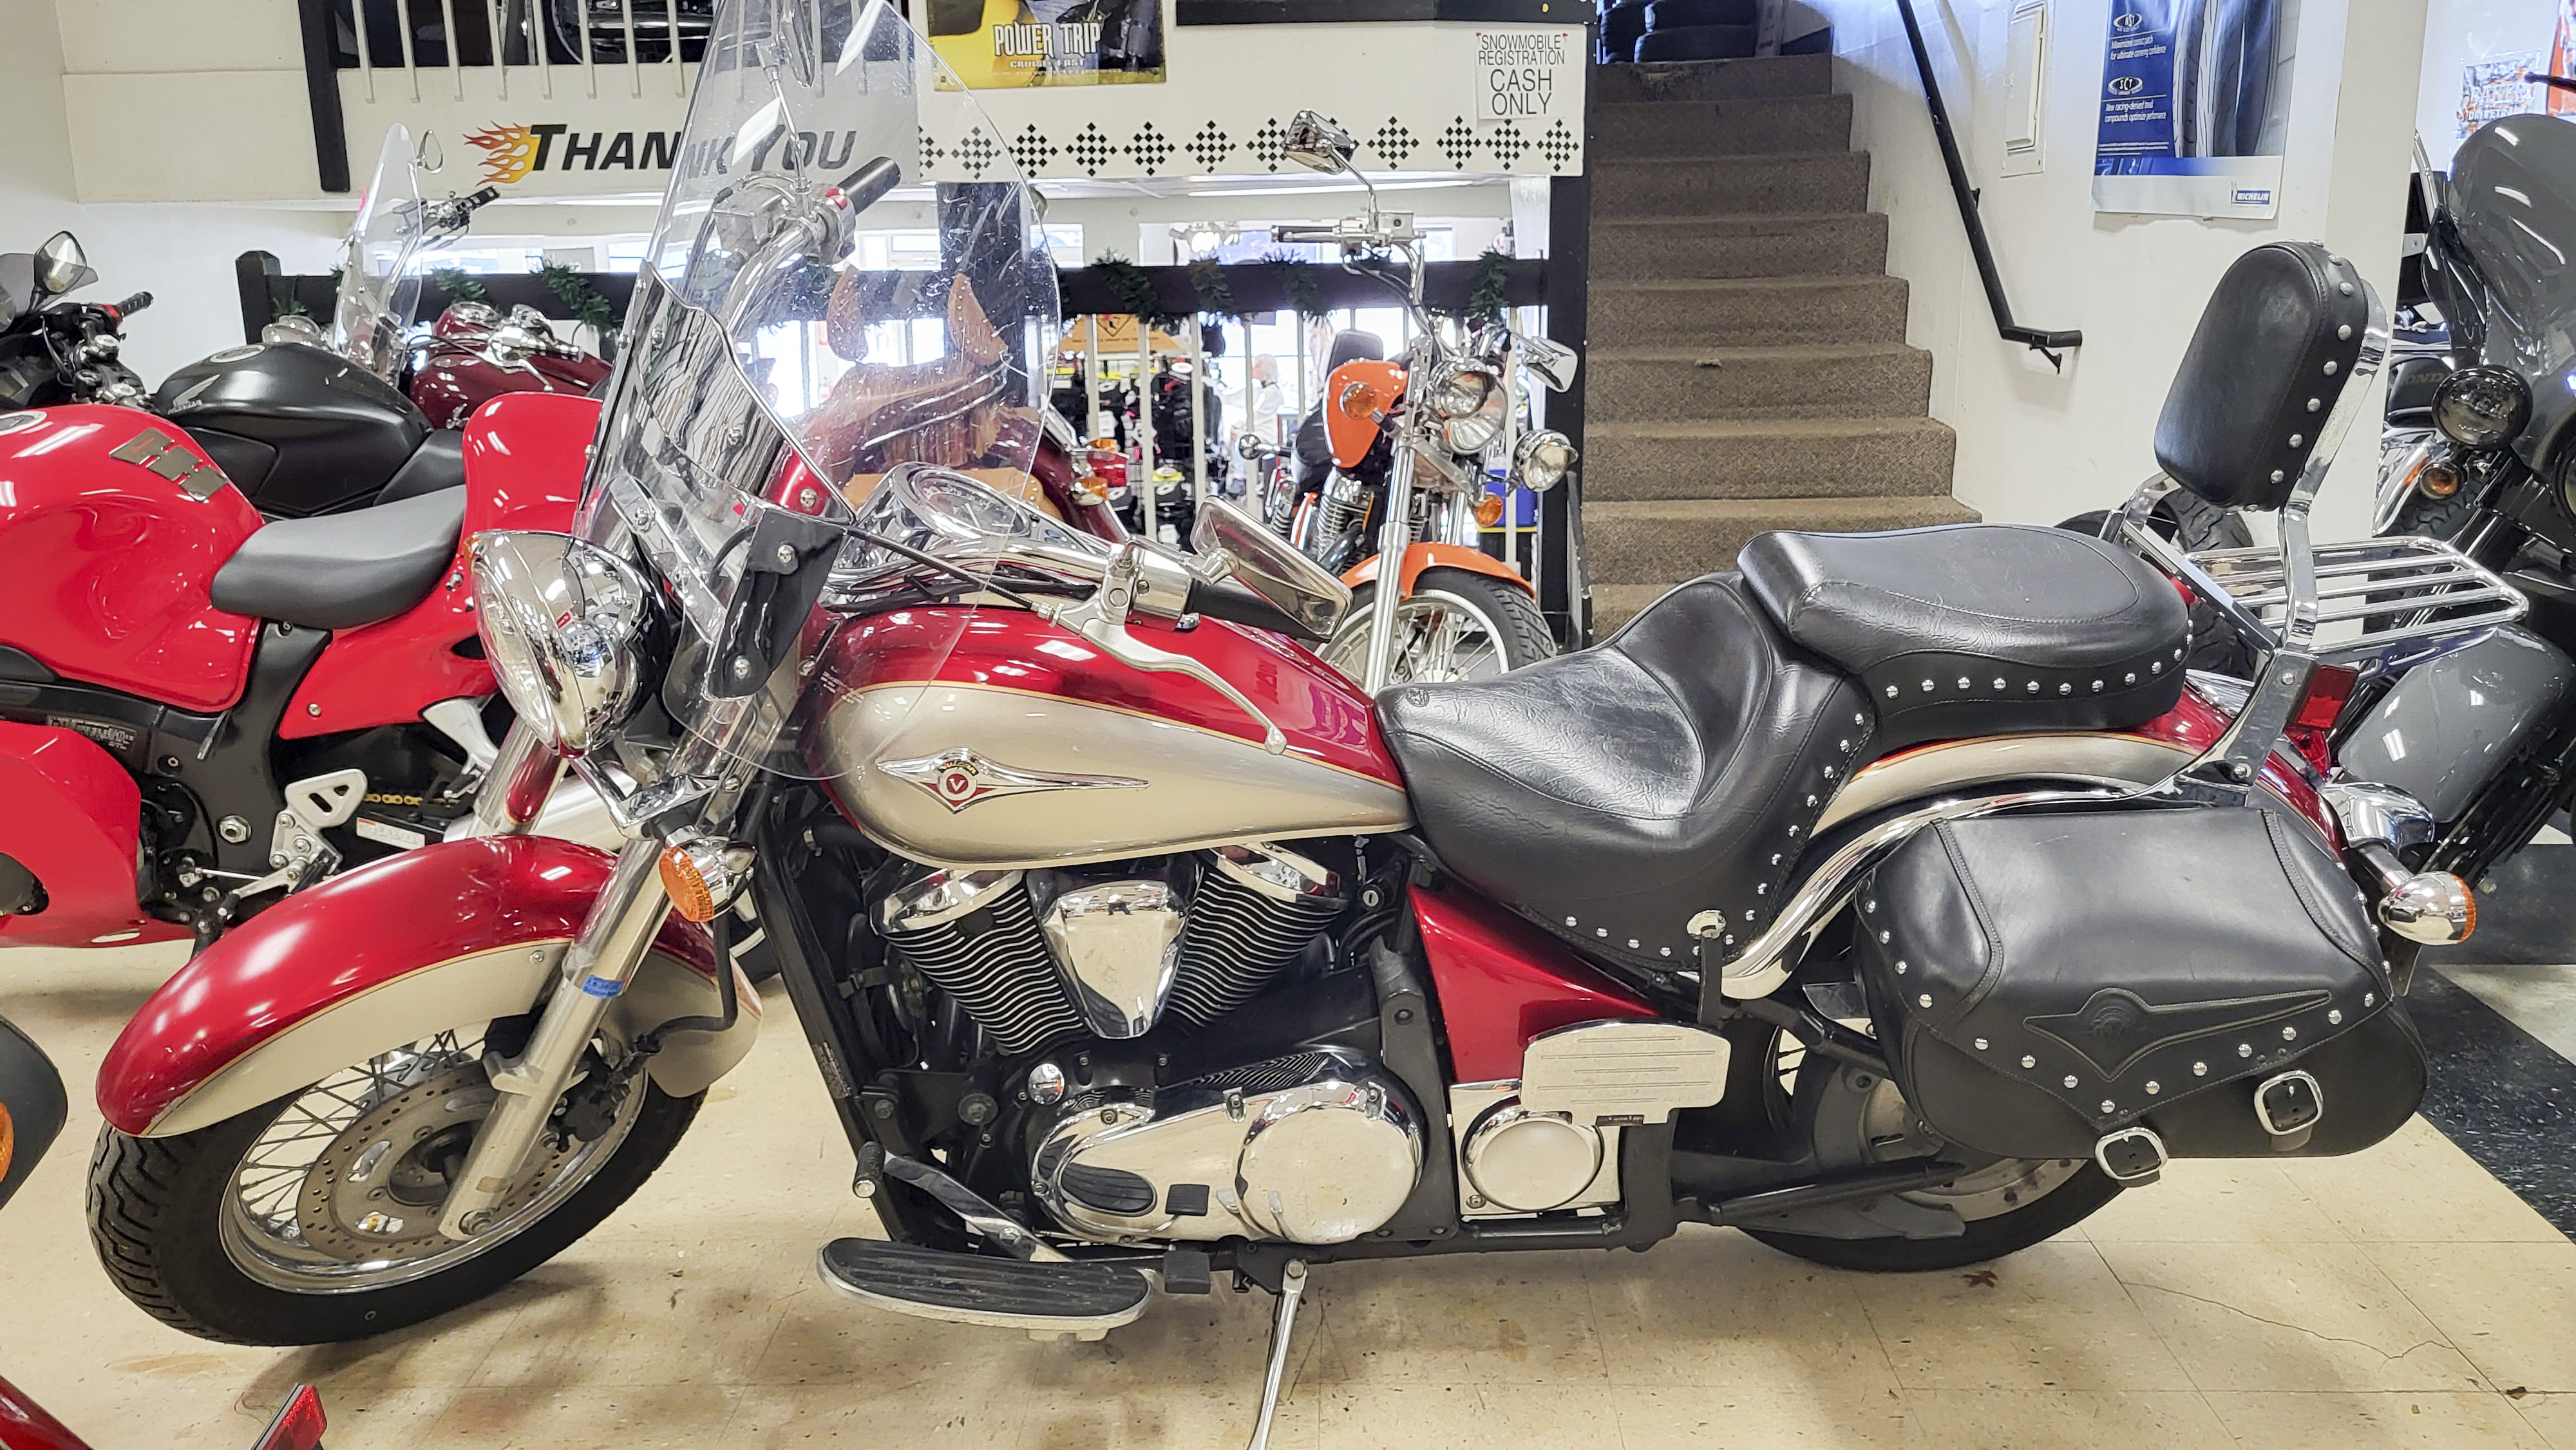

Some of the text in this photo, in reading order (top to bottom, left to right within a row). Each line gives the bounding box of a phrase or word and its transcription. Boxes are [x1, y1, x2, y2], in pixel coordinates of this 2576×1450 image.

[994, 21, 1101, 59] POWER TRIP
[1481, 34, 1561, 50] SNOWMOBILE
[1478, 50, 1565, 66] REGISTRATION
[1490, 69, 1552, 92] CASH
[1492, 92, 1552, 116] ONLY
[2237, 192, 2269, 201] MICHELIN
[949, 778, 966, 792] V
